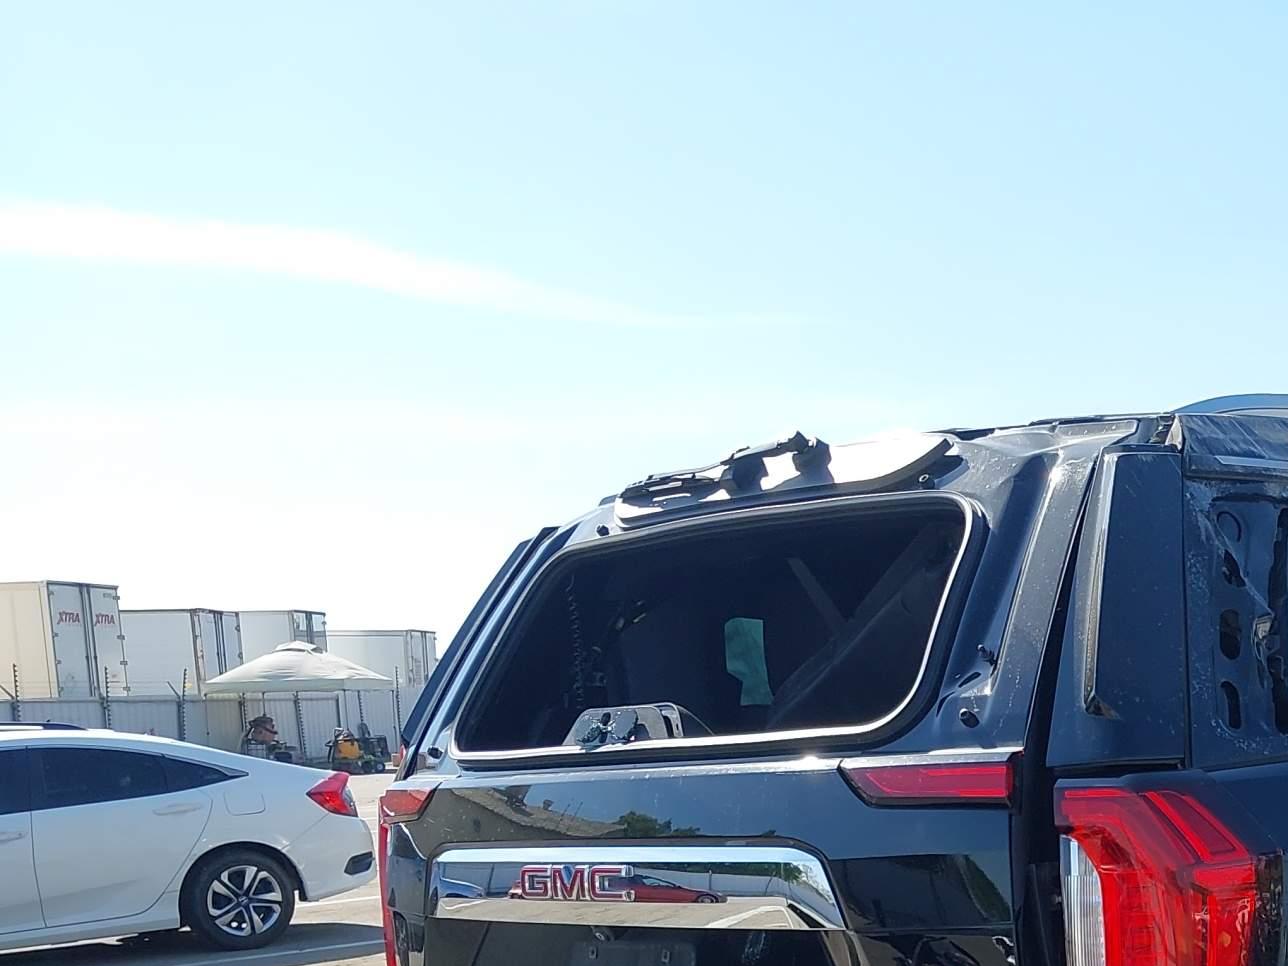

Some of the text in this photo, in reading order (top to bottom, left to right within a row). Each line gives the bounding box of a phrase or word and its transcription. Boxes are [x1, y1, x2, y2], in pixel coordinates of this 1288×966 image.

[57, 611, 80, 625] XTRA
[95, 613, 115, 626] XTRA
[520, 865, 635, 902] GMC
